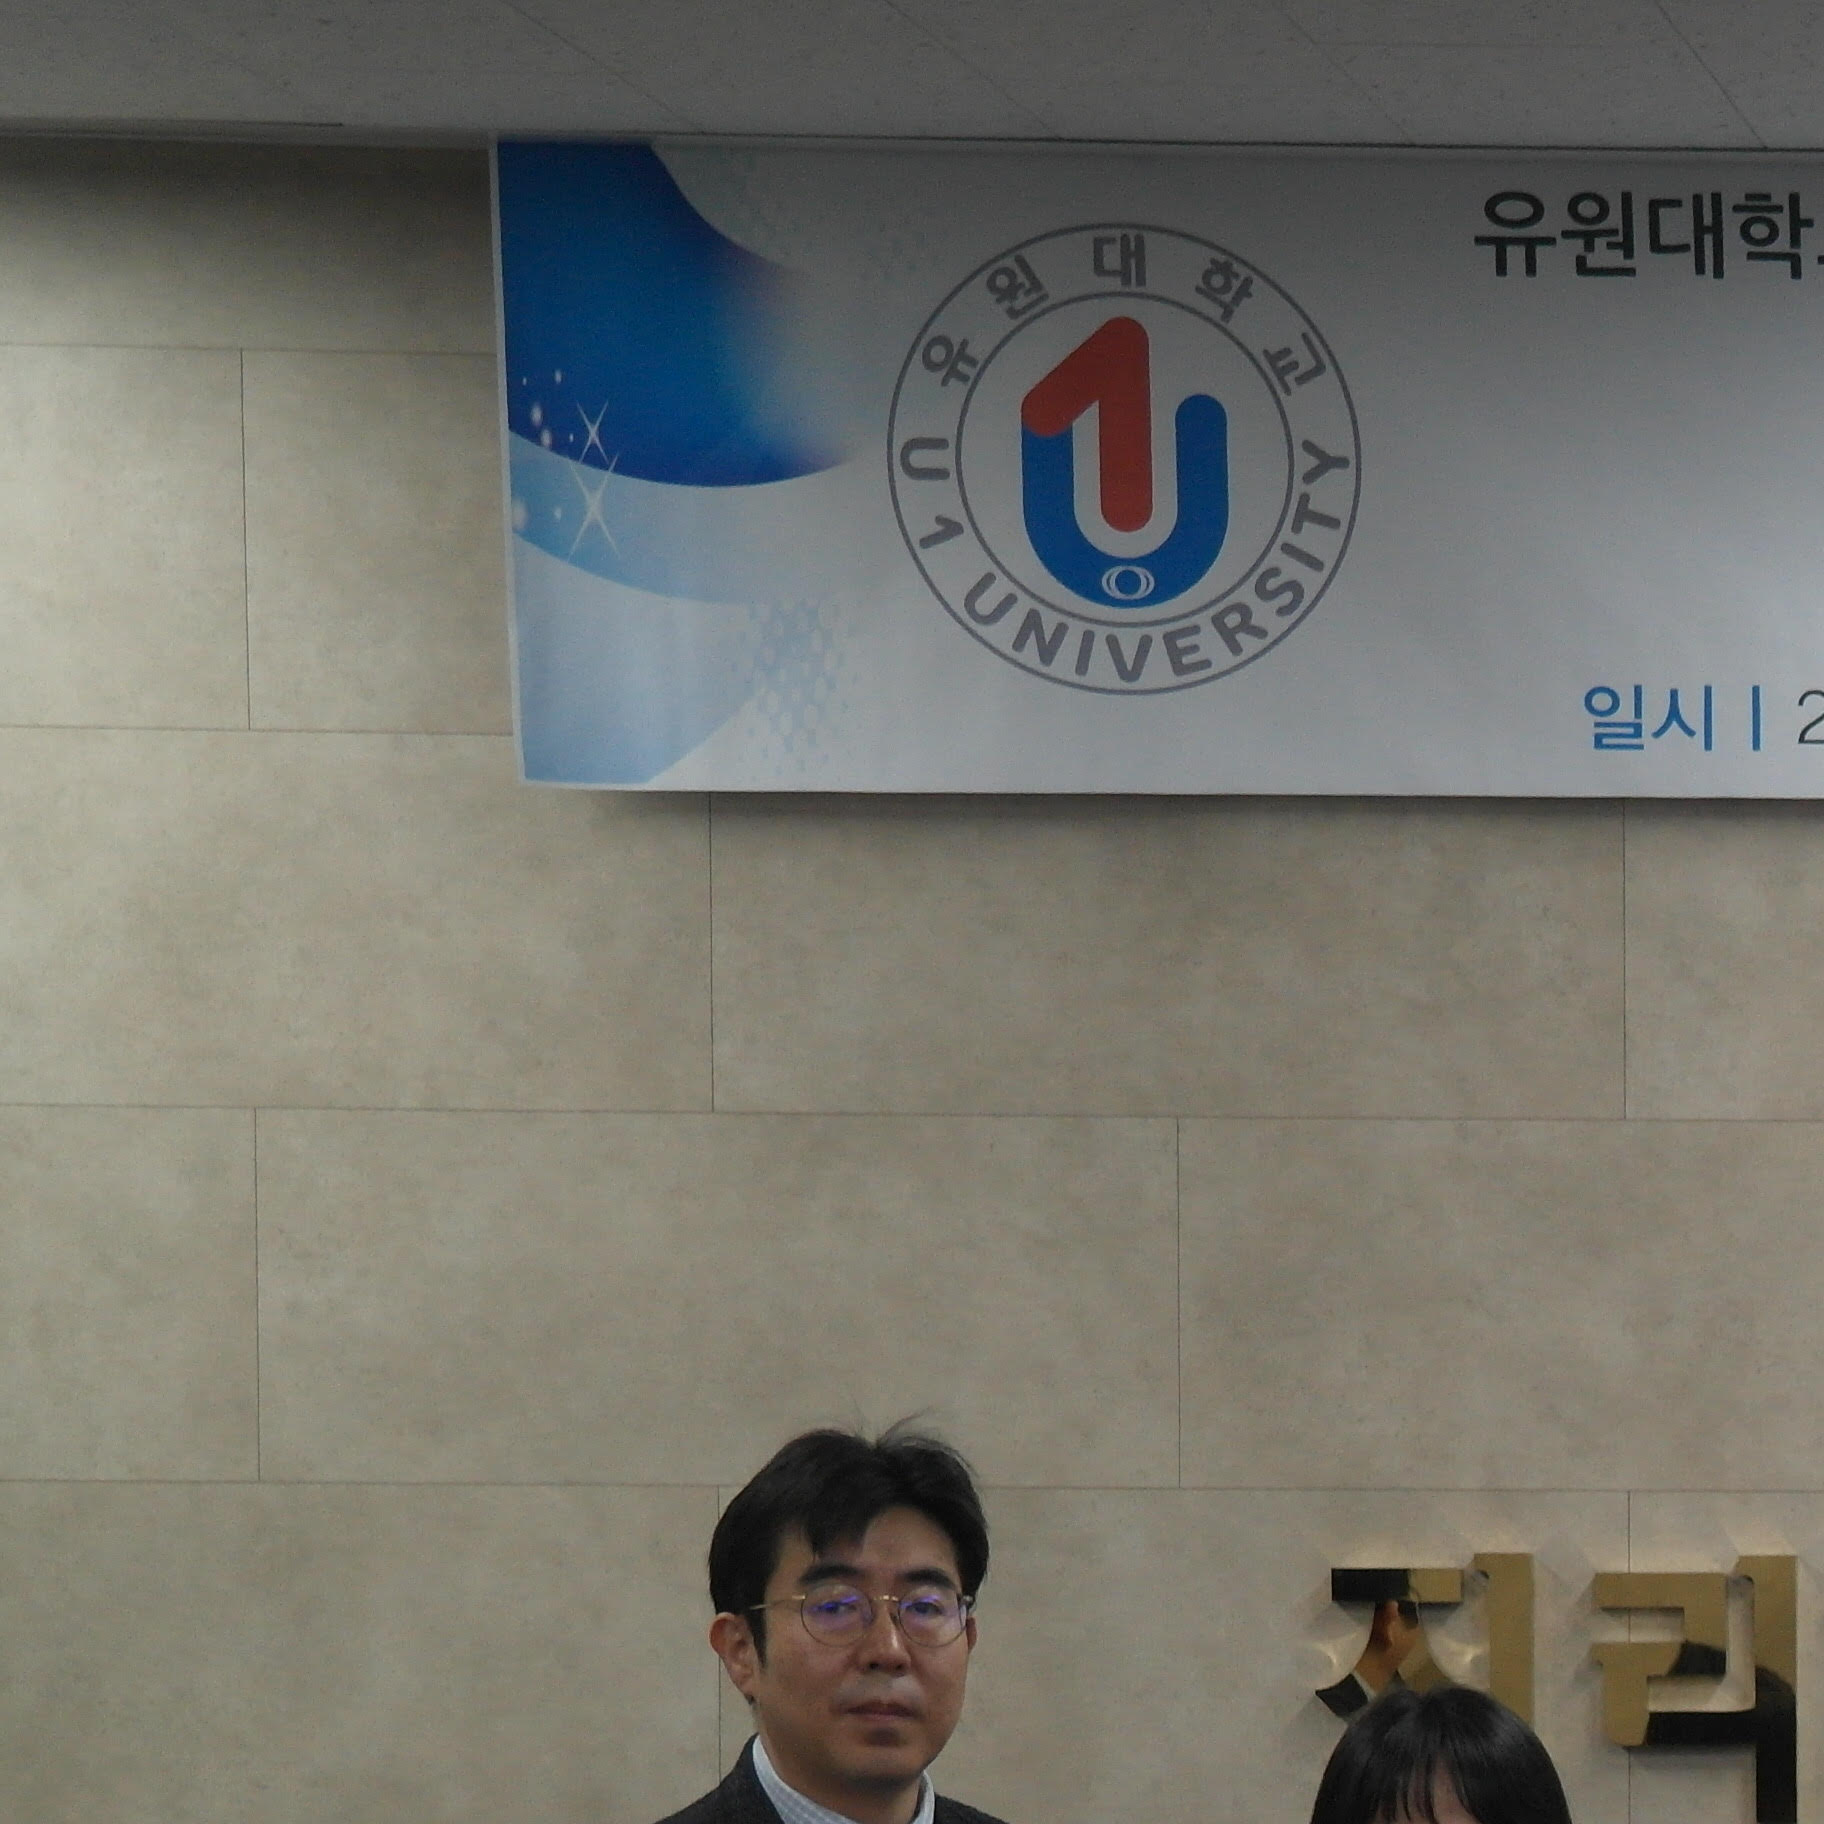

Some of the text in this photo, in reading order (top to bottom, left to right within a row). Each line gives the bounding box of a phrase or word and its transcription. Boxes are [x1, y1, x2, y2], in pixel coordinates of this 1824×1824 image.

[922, 233, 1327, 396] 유원대학교
[963, 439, 1351, 683] UNIVERSITY
[1583, 683, 1714, 752] 일시
